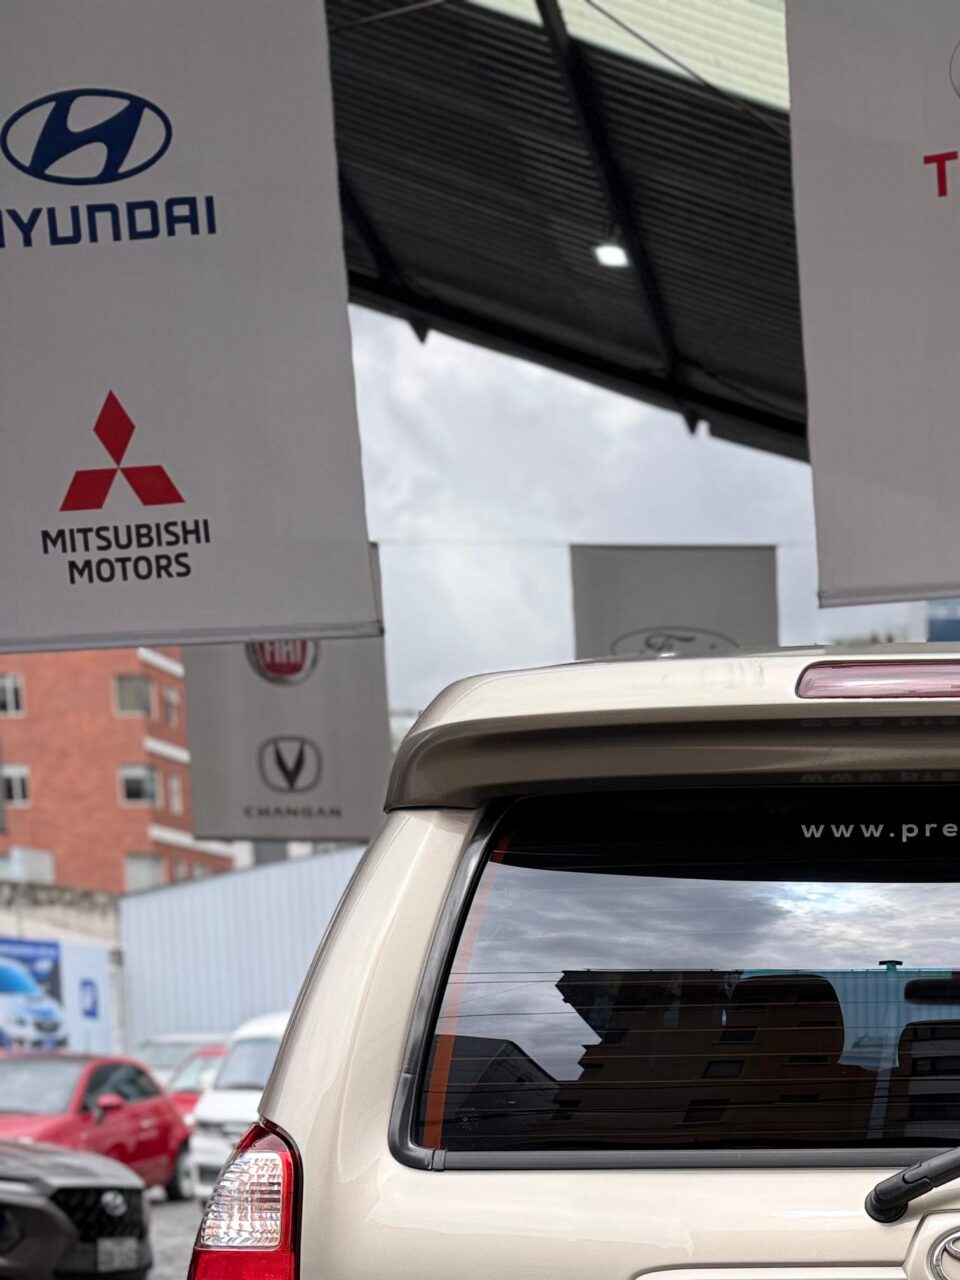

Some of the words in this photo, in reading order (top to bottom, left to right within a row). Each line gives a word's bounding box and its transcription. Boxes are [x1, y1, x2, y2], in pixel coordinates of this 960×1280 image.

[0, 195, 217, 248] YUNDAI
[41, 518, 211, 554] MITSUBISHI
[68, 552, 192, 585] MOTORS
[243, 805, 343, 820] CHANGAN
